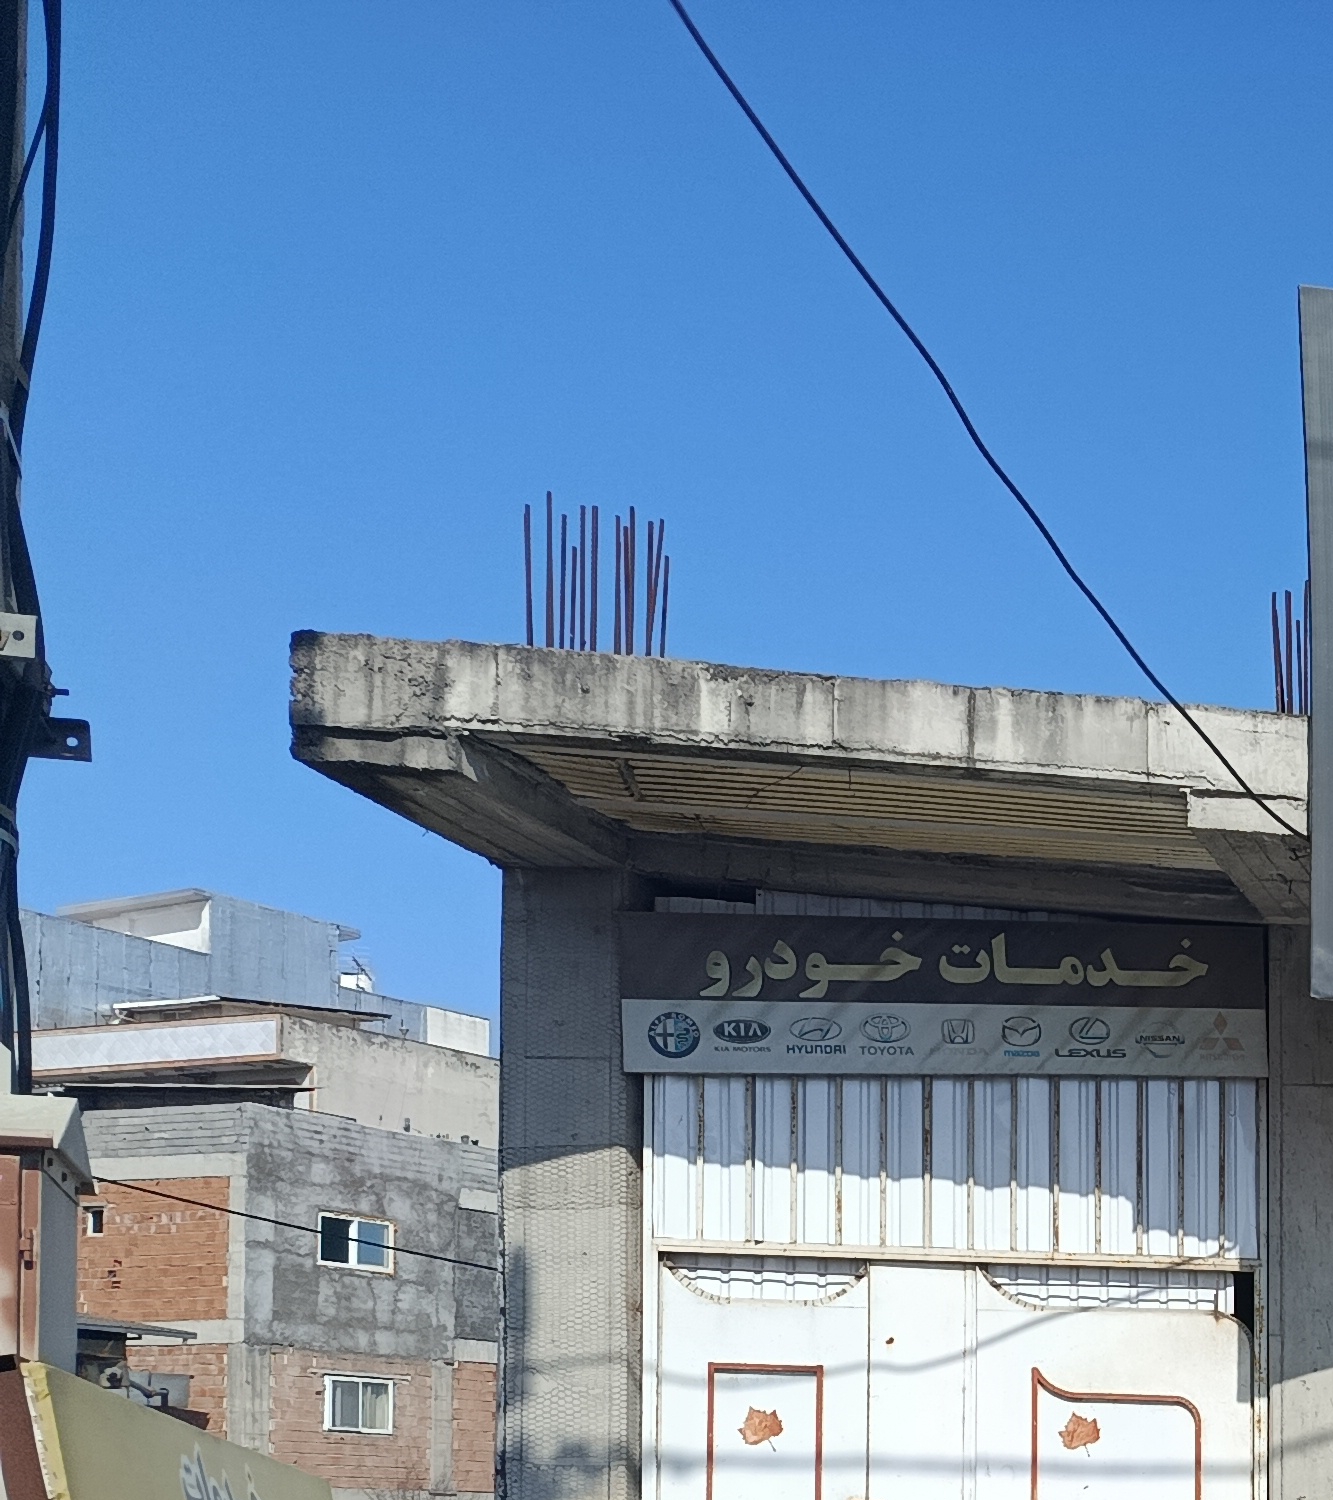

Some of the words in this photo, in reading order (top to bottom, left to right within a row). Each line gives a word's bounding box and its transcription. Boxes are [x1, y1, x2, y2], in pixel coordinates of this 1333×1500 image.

[700, 931, 922, 998] خودرو
[938, 932, 1209, 988] خدمات
[724, 1021, 763, 1036] KIA
[1139, 1034, 1181, 1043] NISSAN
[787, 1044, 847, 1055] HYUNDAI
[859, 1046, 915, 1056] TOYOTA
[1054, 1048, 1126, 1059] LEXUS
